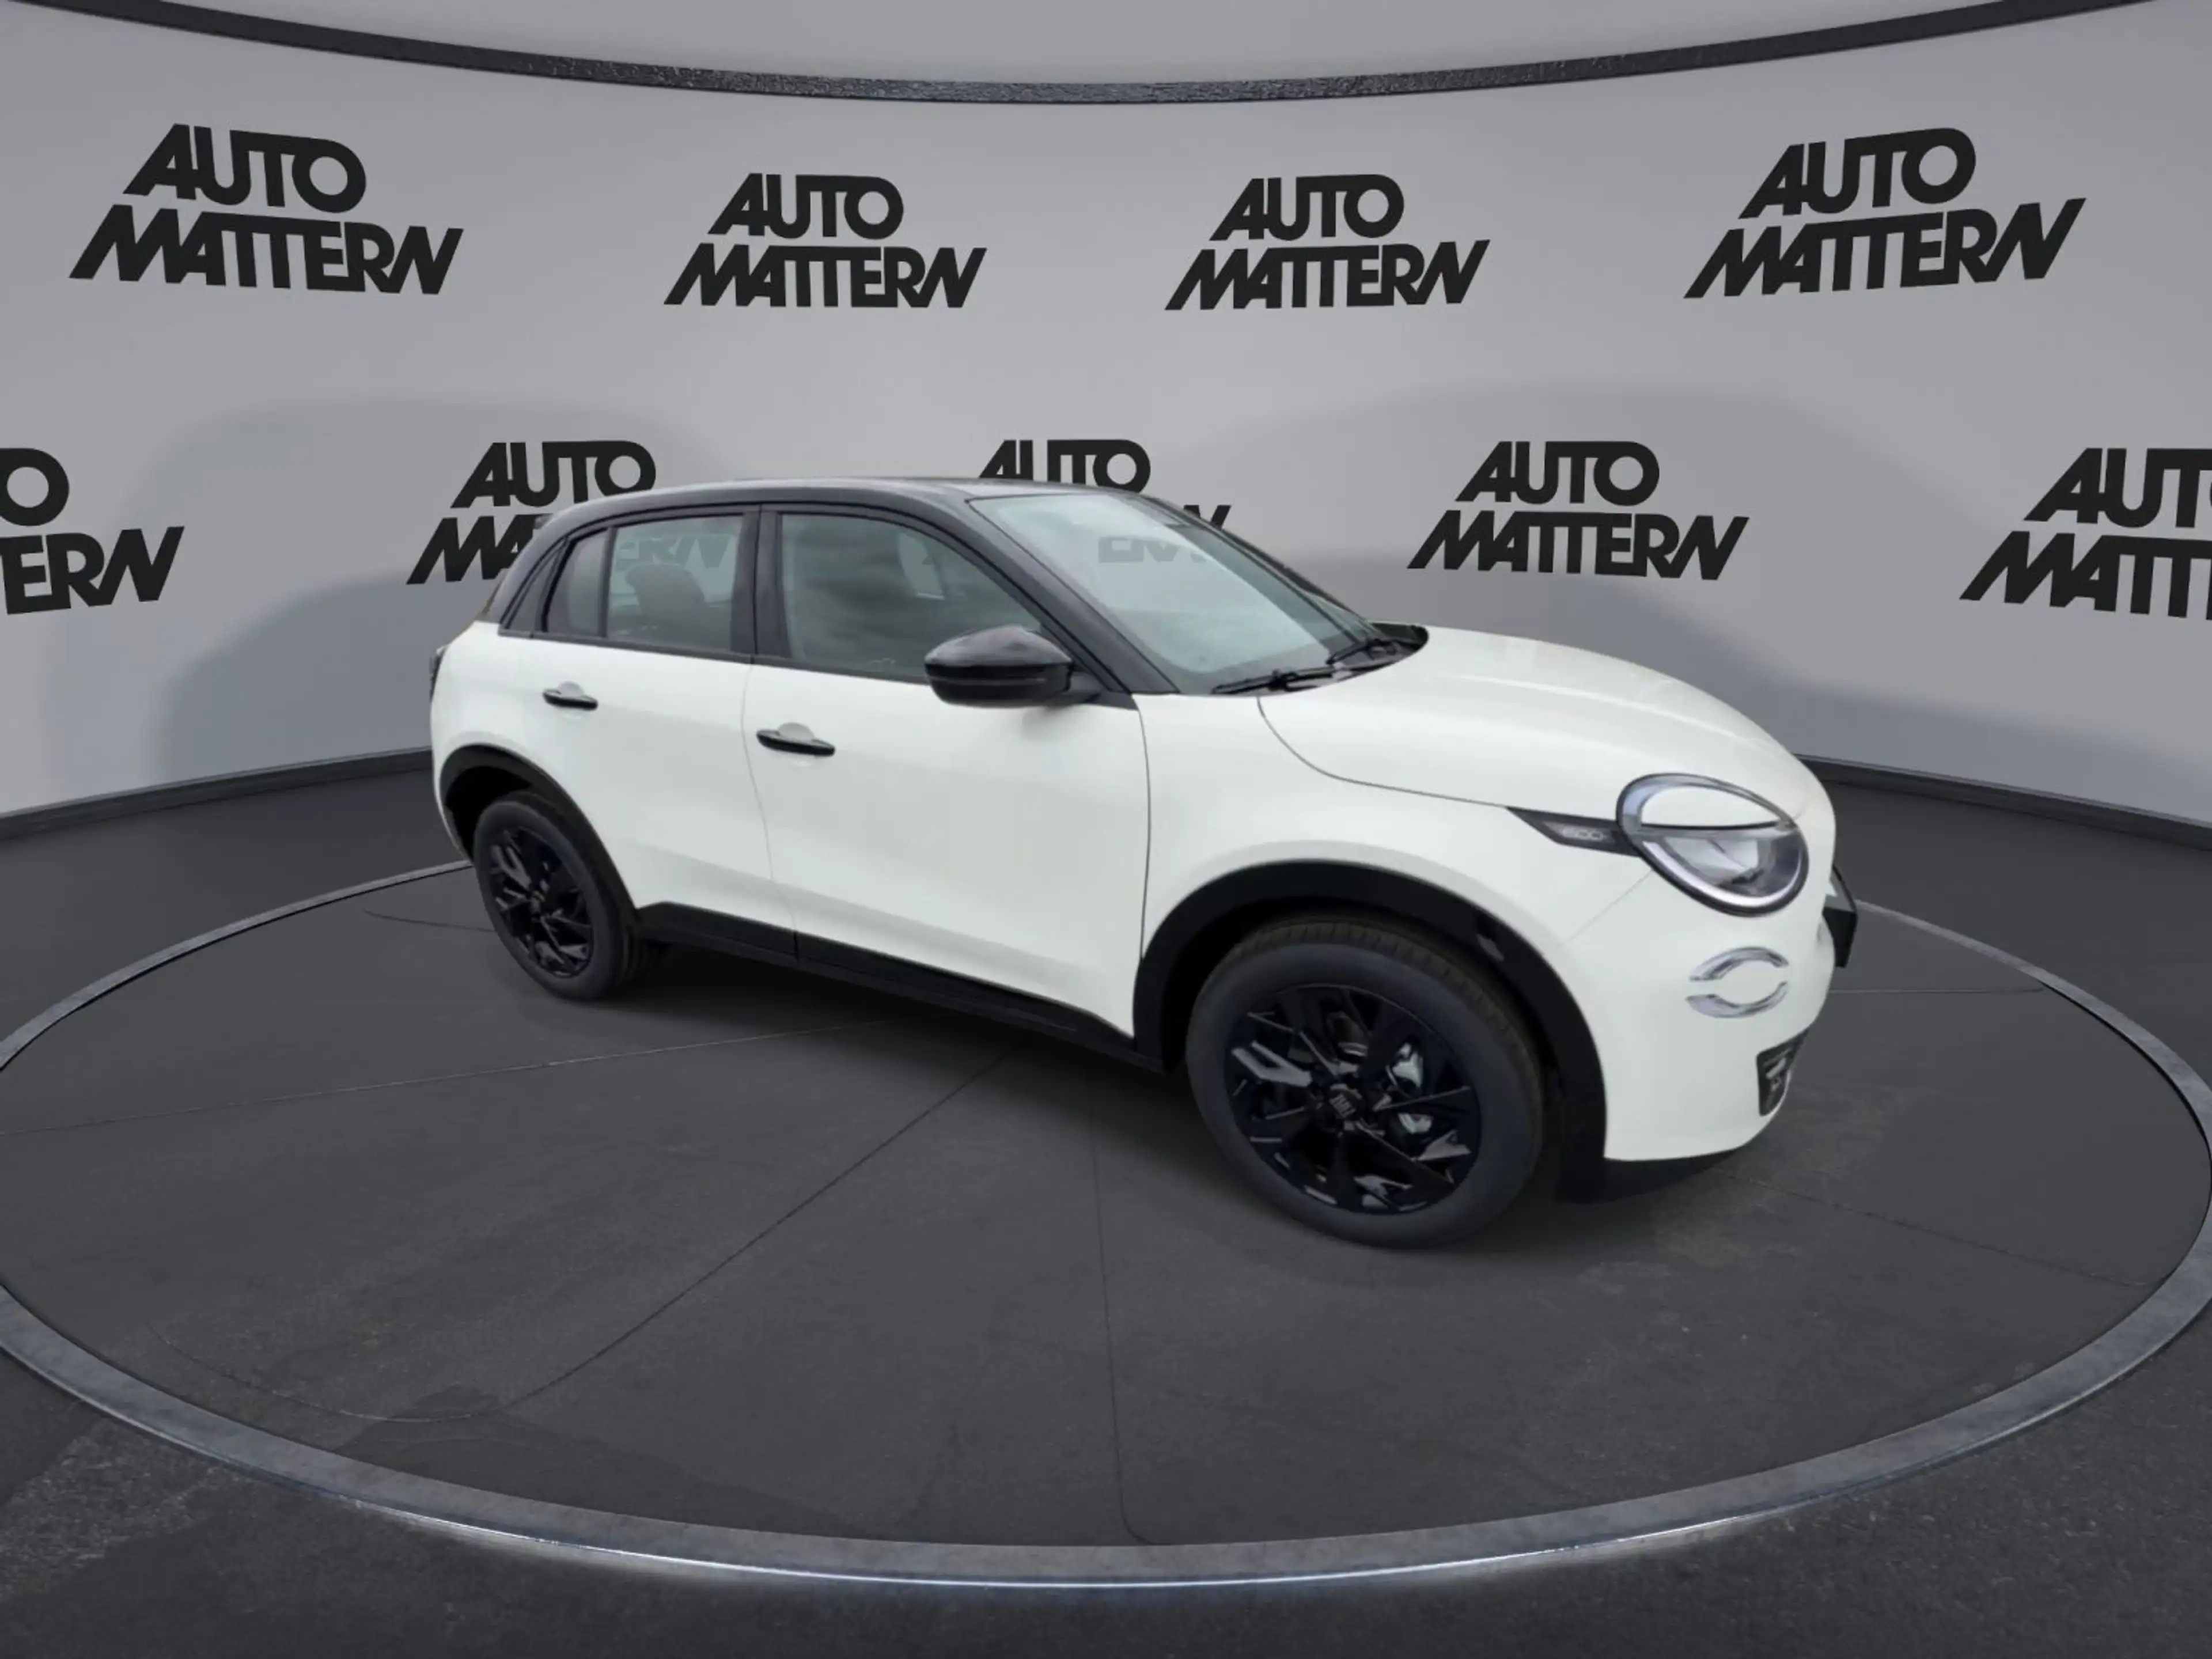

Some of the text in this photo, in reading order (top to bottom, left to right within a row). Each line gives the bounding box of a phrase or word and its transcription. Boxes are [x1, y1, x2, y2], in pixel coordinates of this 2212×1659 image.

[123, 124, 366, 213] AUTO
[1739, 128, 1976, 219] AUTO
[708, 173, 903, 239] AUTO
[1210, 175, 1404, 240] AUTO
[70, 204, 463, 294] MATTERN
[664, 243, 986, 308] MATTERN
[1165, 240, 1490, 310] MATTERN
[1684, 198, 2085, 298] MATTERN
[451, 441, 656, 508] AUTO
[1456, 441, 1659, 506] AUTO
[2024, 448, 2212, 528] AUT
[1407, 510, 1749, 580] MATTERN
[1960, 531, 2212, 620] MATT
